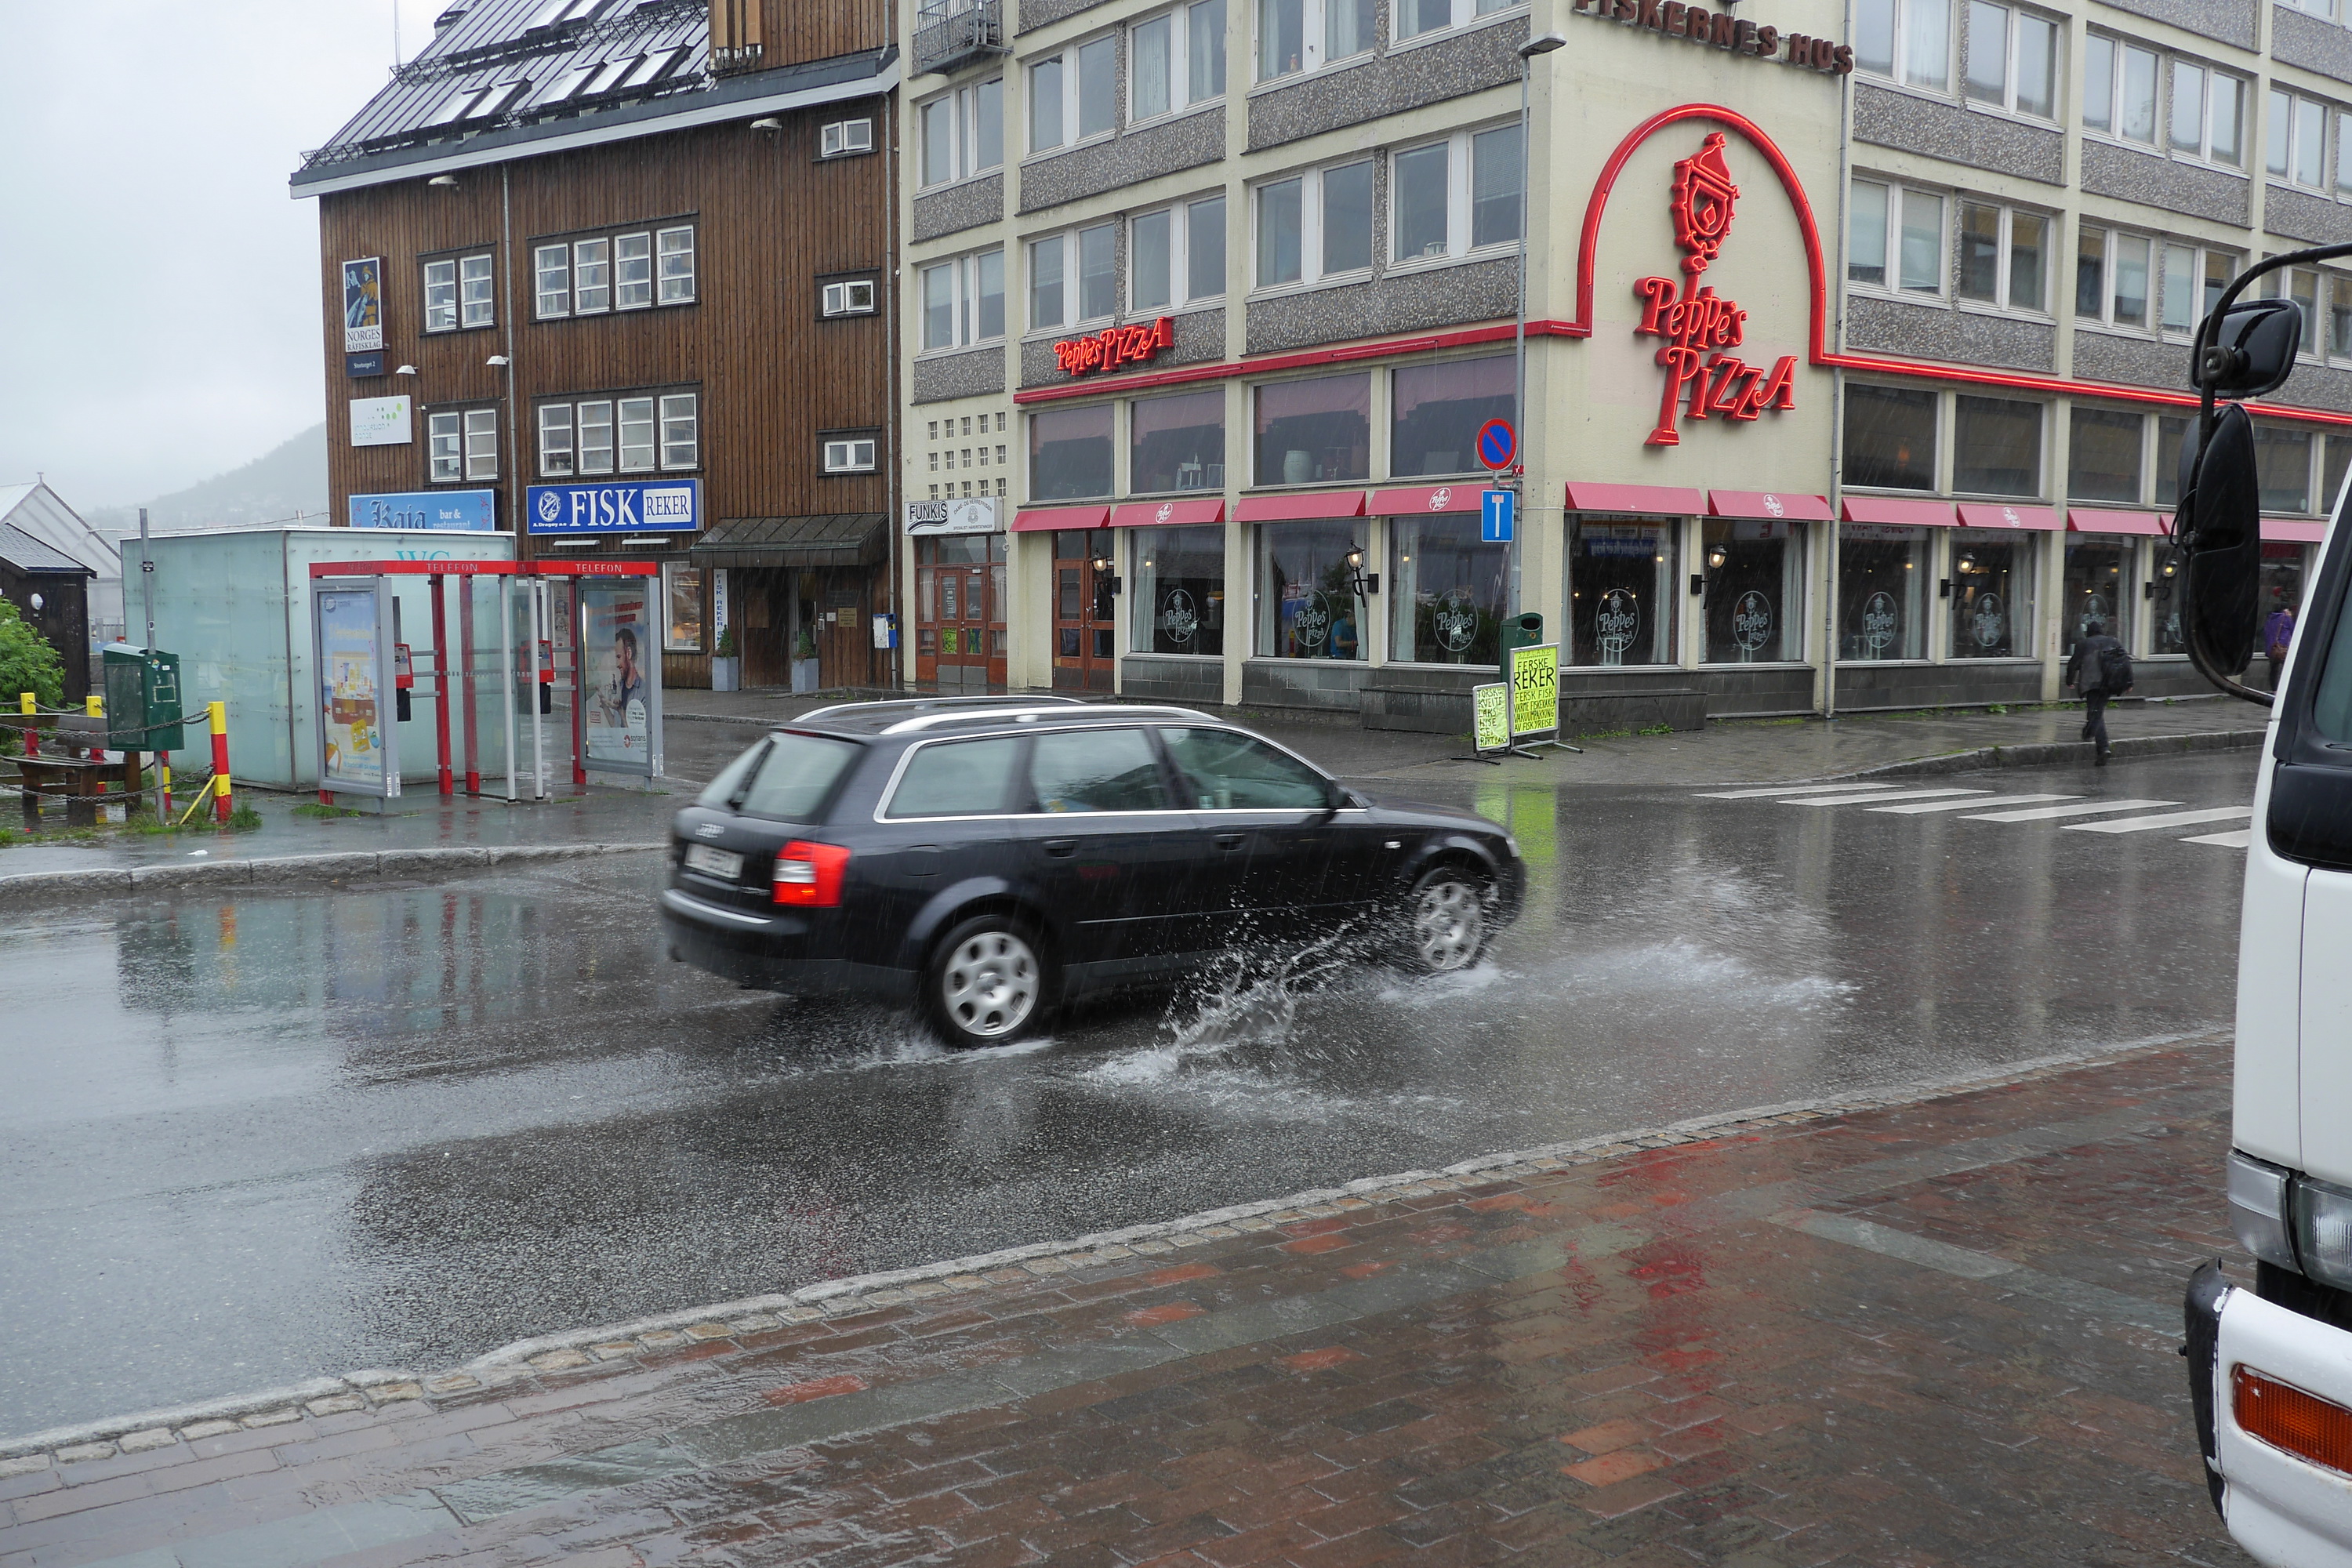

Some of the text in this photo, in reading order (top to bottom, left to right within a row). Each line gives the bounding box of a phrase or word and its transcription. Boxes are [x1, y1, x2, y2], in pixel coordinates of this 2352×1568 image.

[1788, 32, 1854, 75] HUS
[347, 328, 381, 343] NORGES
[347, 340, 381, 351] RÅFISKLAG
[439, 509, 462, 520] bar &
[568, 489, 689, 527] FISK REKER
[909, 500, 949, 522] FUNKIS
[426, 563, 478, 572] TELEFON
[575, 564, 622, 573] TELEFON
[1294, 609, 1327, 628] Peppes
[1436, 611, 1473, 631] Peppes
[1599, 611, 1635, 632] Peppes
[1736, 612, 1769, 632] Peppes
[1517, 657, 1548, 673] FERSKE
[1514, 666, 1555, 691] REKER
[1477, 689, 1498, 698] TORSK
[1515, 688, 1554, 702] FERSK FISK
[1478, 697, 1502, 708] KVEITE
[1479, 708, 1497, 717] LAKS
[1479, 717, 1497, 728] HYSE
[1514, 723, 1522, 732] AV
[1523, 721, 1534, 731] FISK
